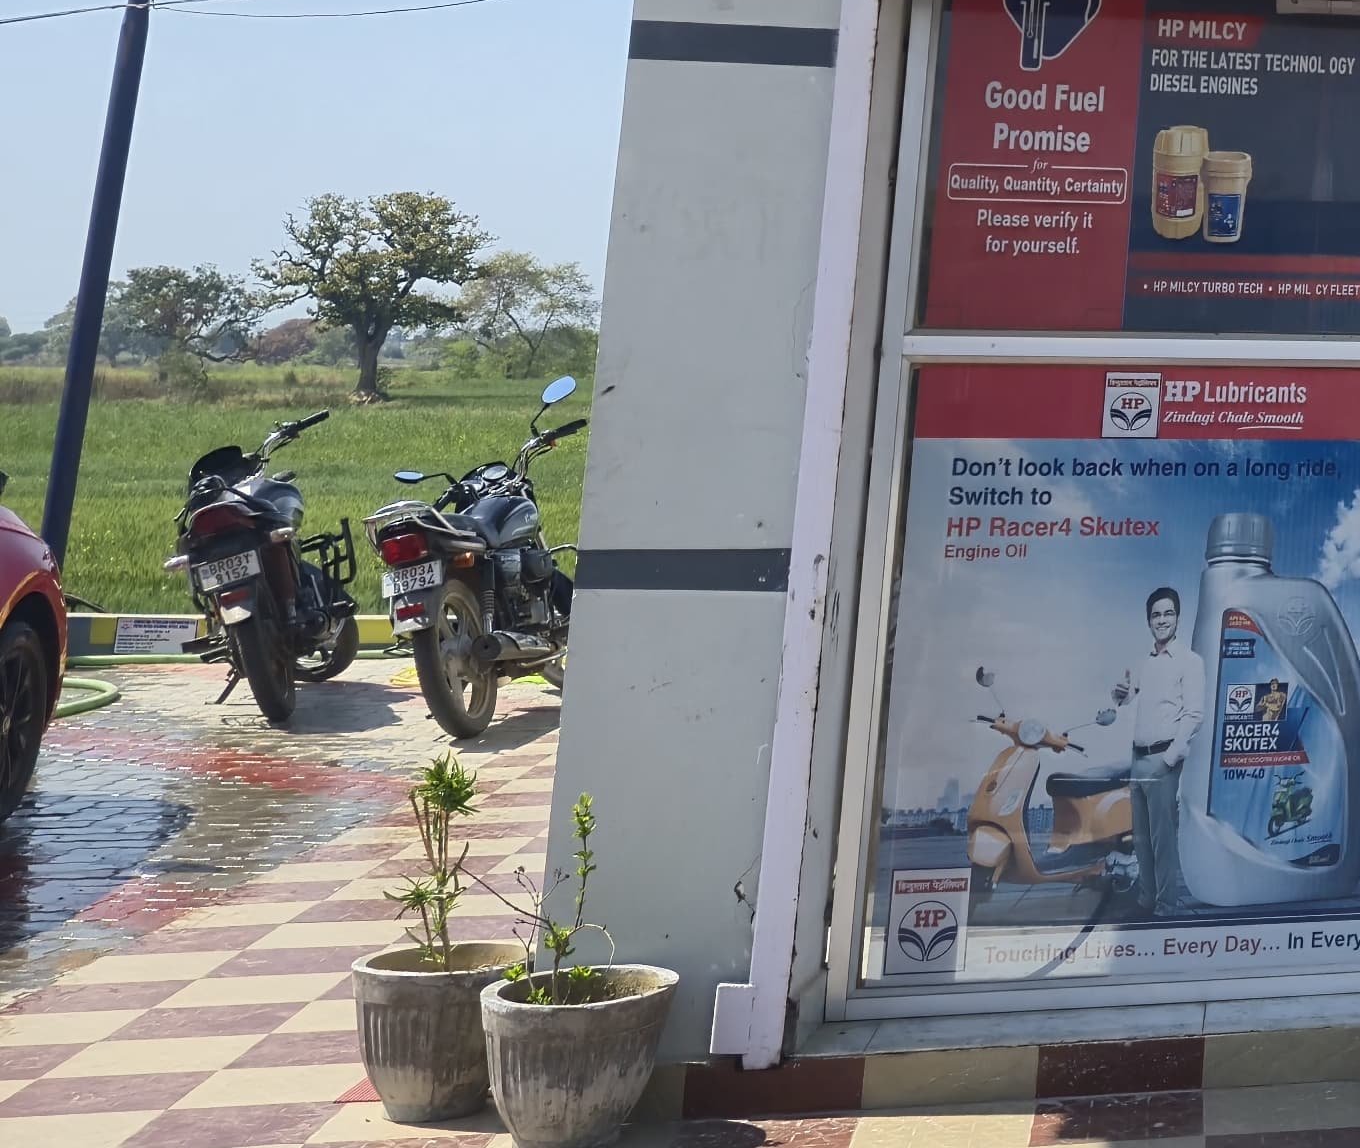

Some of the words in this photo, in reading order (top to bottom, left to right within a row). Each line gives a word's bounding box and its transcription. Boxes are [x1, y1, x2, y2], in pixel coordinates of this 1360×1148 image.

[1158, 19, 1184, 38] HP
[1189, 21, 1247, 41] MILCY
[1152, 50, 1178, 68] FOR
[1181, 51, 1207, 69] THE
[1211, 52, 1261, 72] LATEST
[1150, 74, 1196, 94] DIESEL
[1200, 77, 1258, 96] ENGINES
[985, 81, 1047, 110] Good
[1055, 84, 1105, 112] Fuel
[993, 123, 1090, 153] Promise
[1031, 159, 1048, 173] for
[951, 175, 999, 193] Quality,
[1004, 176, 1060, 195] Quantity,
[1065, 178, 1123, 197] Certainty
[977, 209, 1030, 228] Please
[1034, 212, 1078, 232] verify
[1083, 212, 1093, 229] it
[986, 236, 1008, 253] for
[1012, 237, 1080, 256] yourself.
[1153, 282, 1168, 293] HP
[1170, 282, 1200, 293] MILCY
[1202, 282, 1235, 293] TURBO
[1237, 283, 1263, 294] TECH
[1164, 381, 1201, 402] HP
[1204, 381, 1307, 403] Lubricants
[1121, 398, 1144, 409] HP
[1163, 411, 1215, 428] Zindagi
[1218, 412, 1254, 424] Chale
[1256, 411, 1304, 424] Smooth
[951, 457, 1012, 477] Don't
[1018, 458, 1065, 477] look
[1071, 458, 1123, 477] back
[1130, 458, 1186, 477] when
[1193, 461, 1219, 477] on
[1226, 461, 1238, 477] a
[1245, 458, 1290, 481] long
[1297, 459, 1342, 480] ride,
[948, 486, 1023, 505] Switch
[1031, 488, 1053, 505] to
[946, 517, 981, 537] HP
[989, 517, 1072, 537] Racer4
[1080, 516, 1160, 537] Skutex
[944, 544, 1000, 561] Engine
[1005, 544, 1027, 558] Oil
[209, 553, 249, 575] BR03Y
[394, 563, 433, 582] BR03A
[215, 566, 249, 585] 8152
[1225, 723, 1279, 738] RACER4
[1224, 737, 1278, 752] SKUTEX
[1223, 769, 1265, 781] 10W-40
[914, 909, 947, 928] HP
[984, 945, 1076, 965] Touching
[1083, 942, 1155, 960] Lives...
[1163, 938, 1217, 958] Every
[1225, 935, 1280, 955] Day...
[1288, 932, 1304, 949] In
